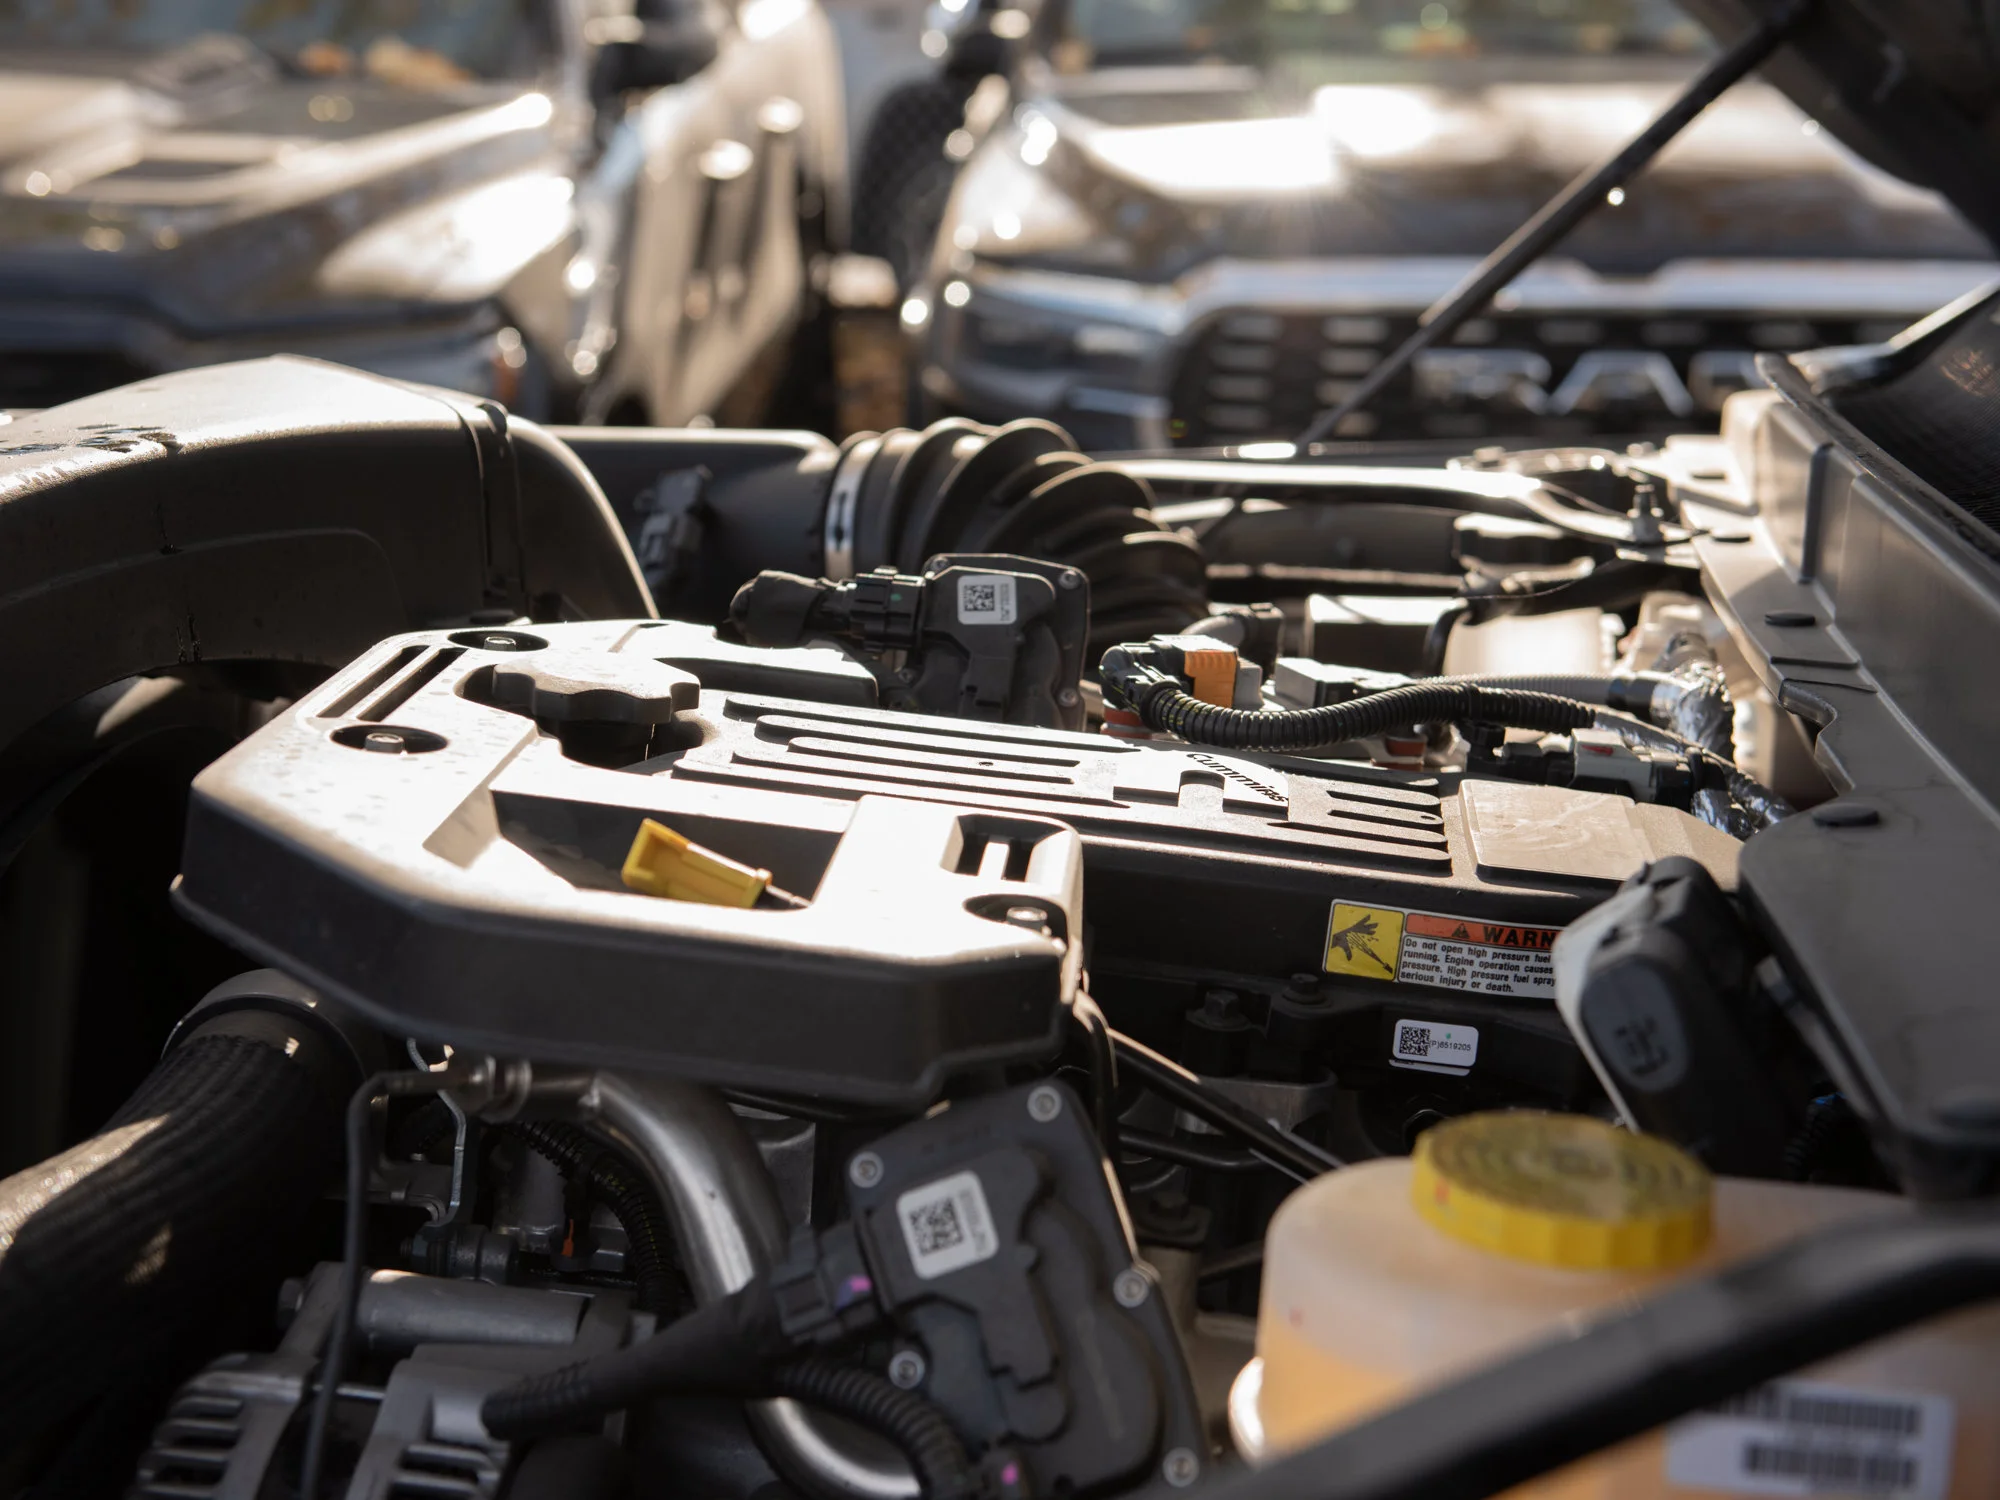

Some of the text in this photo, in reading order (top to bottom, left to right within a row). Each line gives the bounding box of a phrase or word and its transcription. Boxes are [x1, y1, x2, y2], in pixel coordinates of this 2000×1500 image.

[1403, 949, 1554, 975] running. Engine operation causes
[1405, 938, 1551, 964] Do not open high pressure fuel
[1400, 971, 1514, 993] serious injury or death.
[1401, 960, 1556, 988] pressure. High pressure fuel spray
